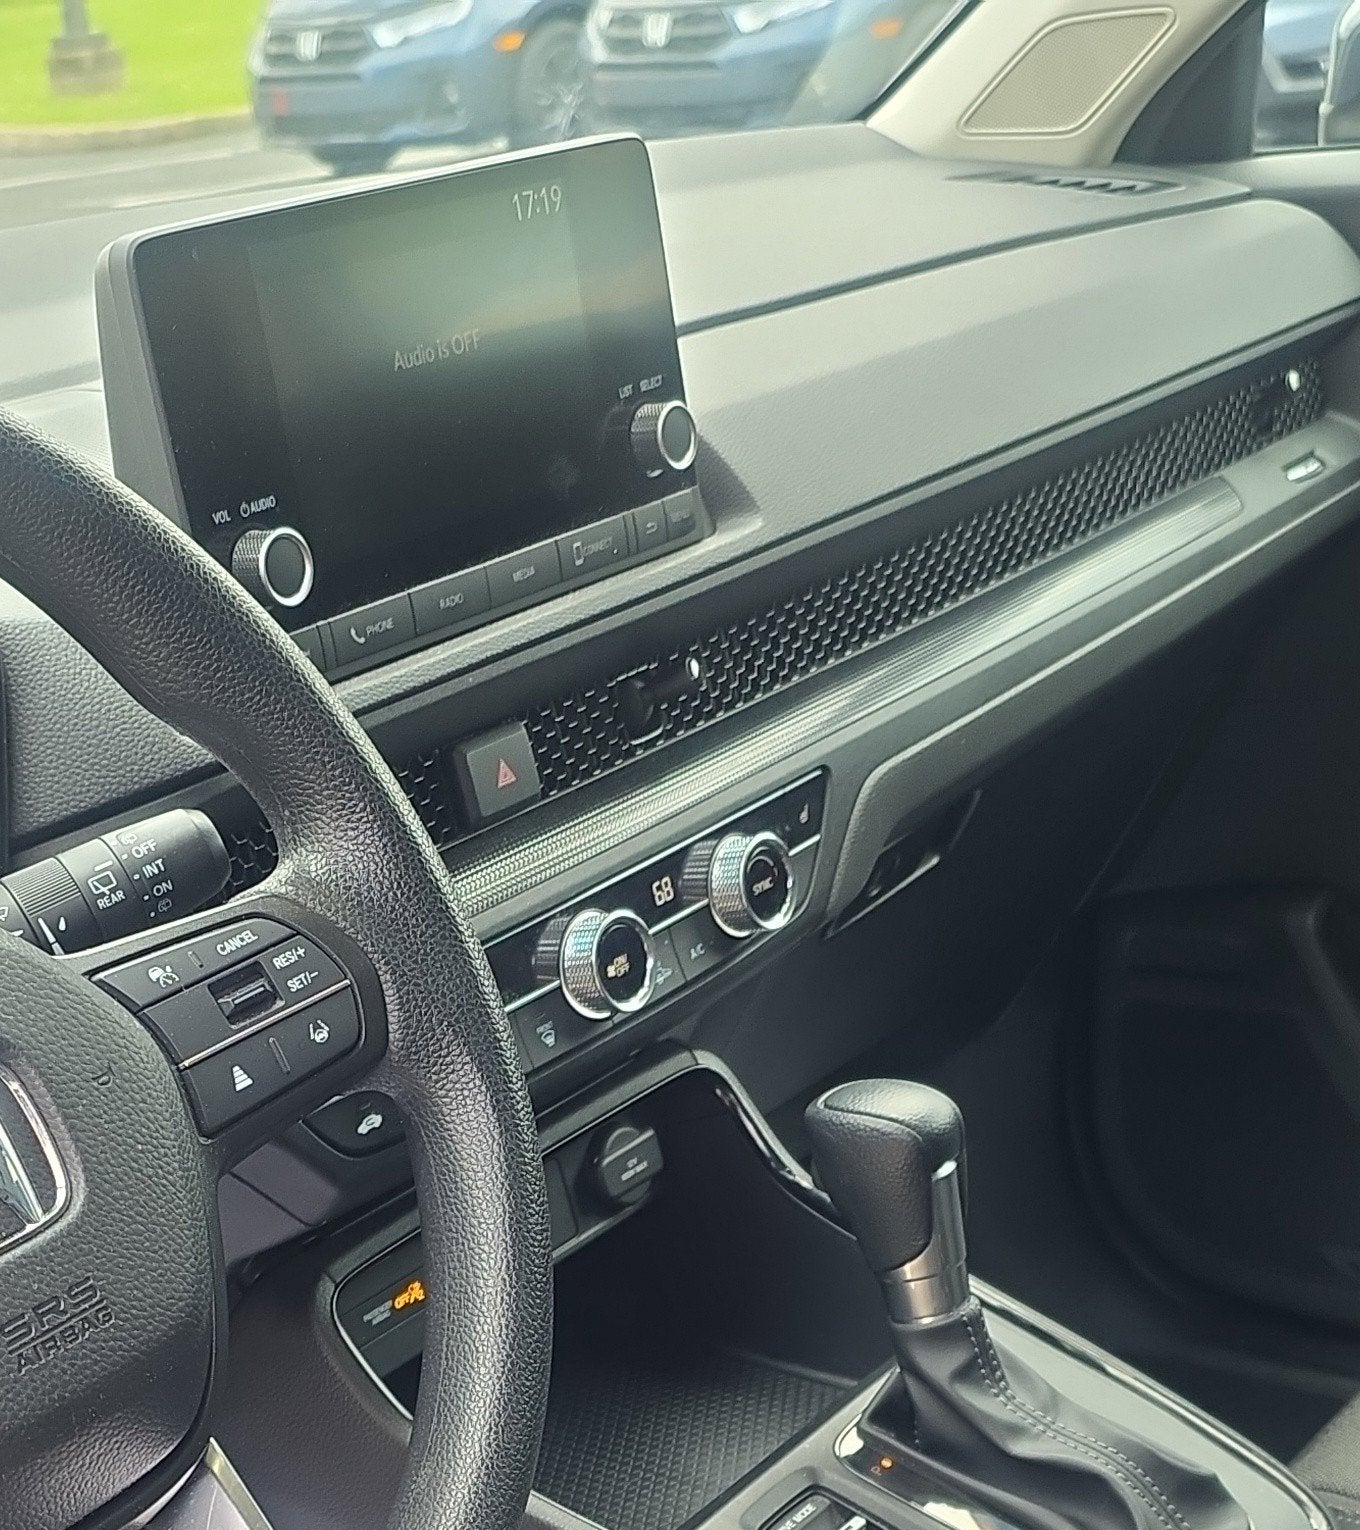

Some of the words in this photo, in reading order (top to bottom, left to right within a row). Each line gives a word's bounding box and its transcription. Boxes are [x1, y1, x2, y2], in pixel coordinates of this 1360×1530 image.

[512, 185, 562, 221] 17:19
[394, 344, 435, 372] Audio
[436, 339, 449, 361] is
[451, 328, 479, 355] OFF
[250, 495, 276, 514] AUDIO
[211, 509, 232, 525] VOL
[365, 617, 395, 638] PHONE
[131, 839, 158, 860] OFF
[142, 858, 166, 879] INT
[152, 879, 174, 898] ON
[652, 876, 675, 907] 68
[96, 890, 127, 911] REAR
[216, 929, 259, 956] CANCEL
[272, 946, 306, 970] RES/+
[0, 1277, 101, 1351] SRS
[18, 1306, 115, 1376] AIRBAG
